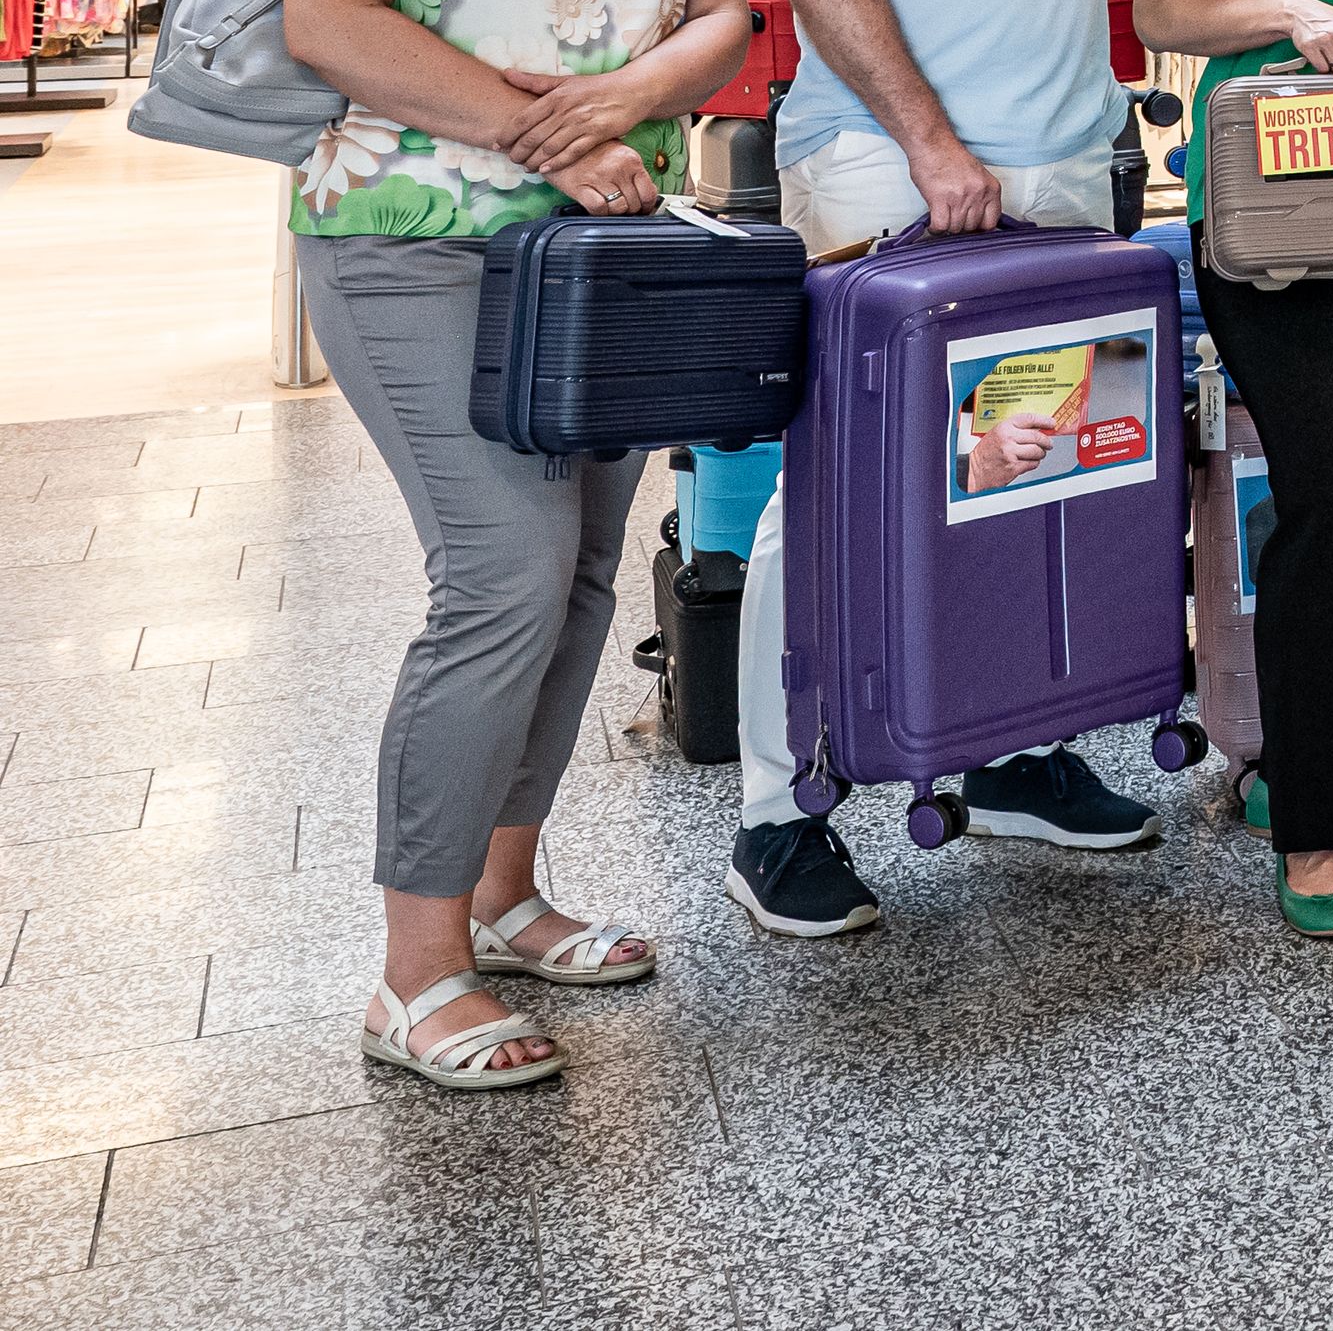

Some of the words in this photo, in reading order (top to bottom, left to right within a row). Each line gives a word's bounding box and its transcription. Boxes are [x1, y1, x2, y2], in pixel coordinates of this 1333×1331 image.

[1003, 364, 1025, 375] FOLGEN
[1025, 363, 1037, 374] FÜR
[1095, 425, 1113, 434] JEDEN
[1113, 422, 1126, 430] TAG
[1119, 427, 1136, 435] EURO
